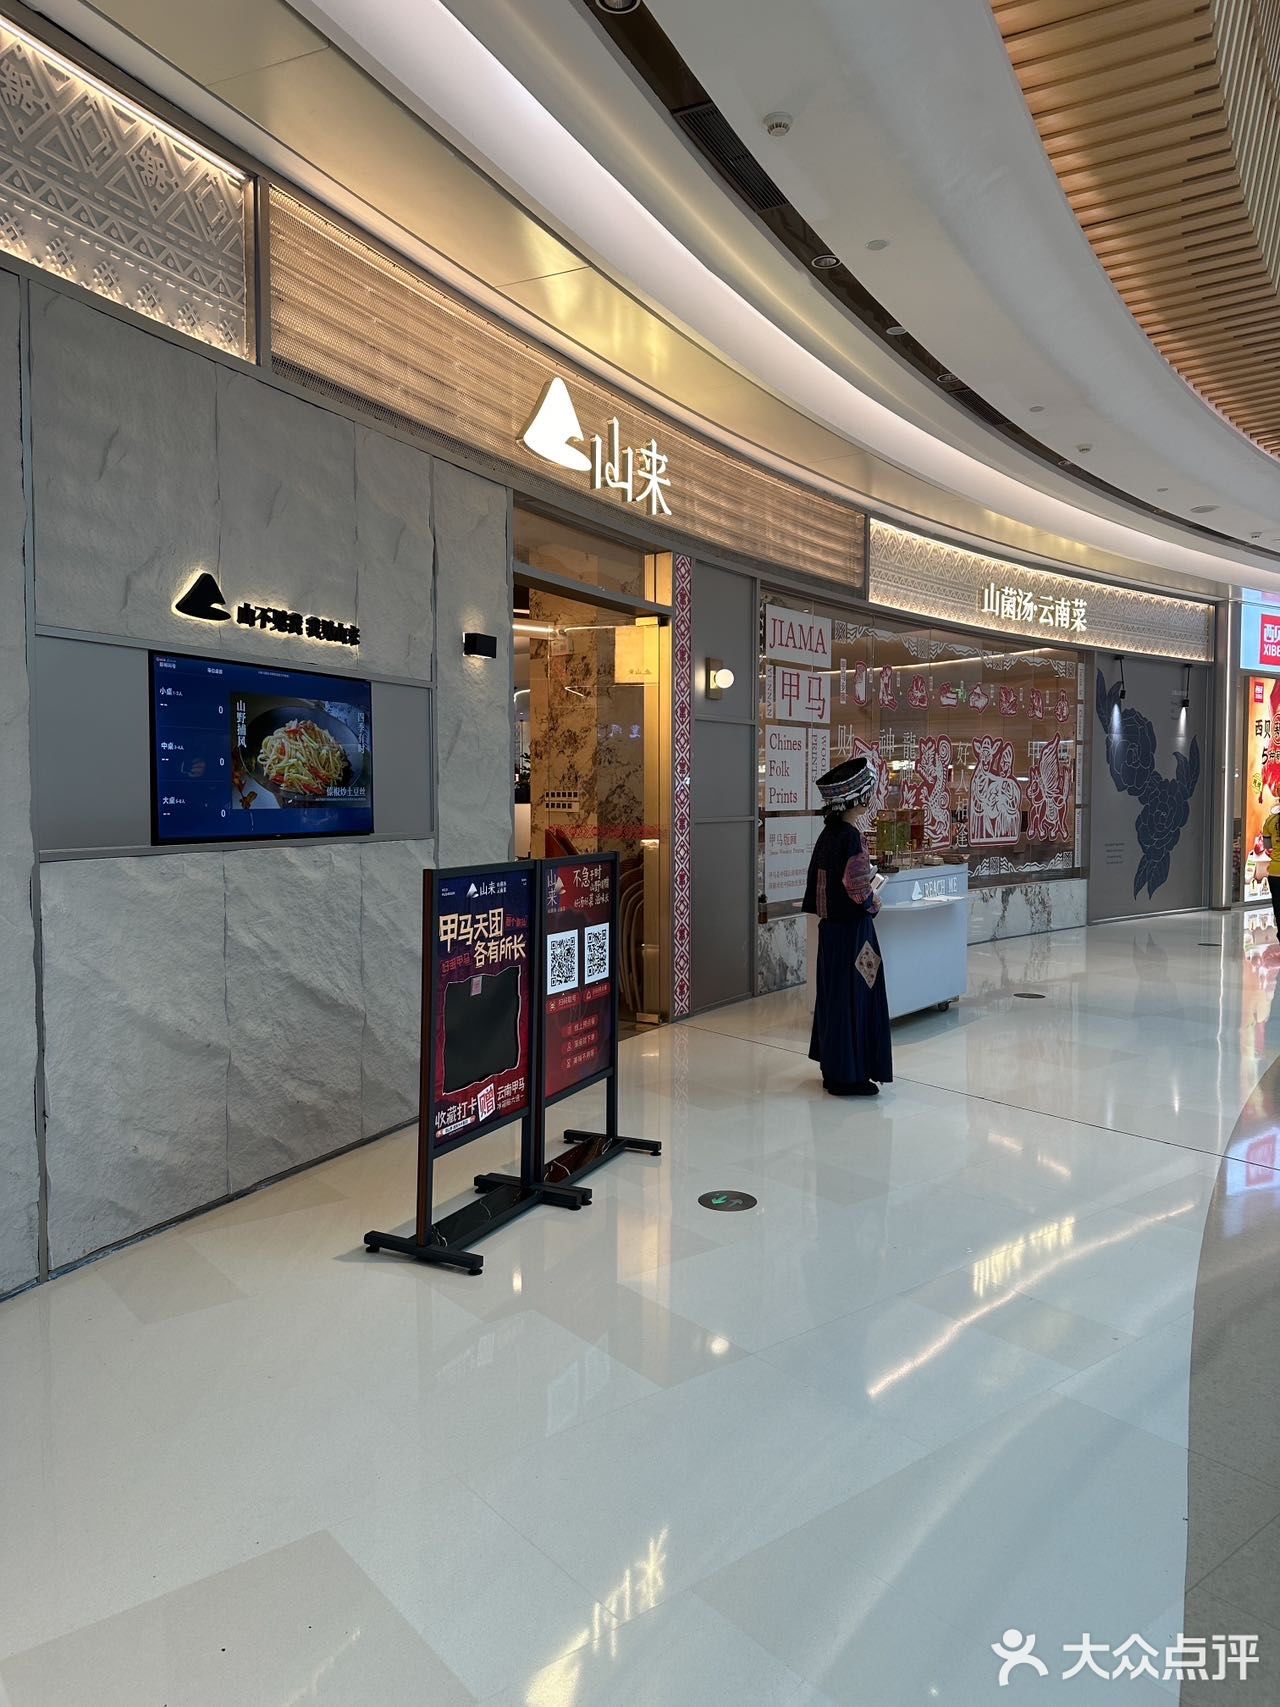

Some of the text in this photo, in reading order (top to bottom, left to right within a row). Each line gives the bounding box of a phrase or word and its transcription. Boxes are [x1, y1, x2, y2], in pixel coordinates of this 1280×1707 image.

[592, 416, 672, 516] 山来
[981, 582, 1088, 632] 山菌汤·云南菜
[769, 617, 828, 655] JIAMA
[781, 669, 826, 720] 甲马
[769, 732, 802, 752] Chines
[769, 759, 791, 778] Folk
[769, 787, 799, 806] Prints
[479, 881, 496, 897] 山来
[438, 907, 504, 954] 甲马天团
[473, 933, 526, 968] 各有所长
[496, 1077, 525, 1101] 云南甲马
[434, 1097, 478, 1129] 收藏打卡
